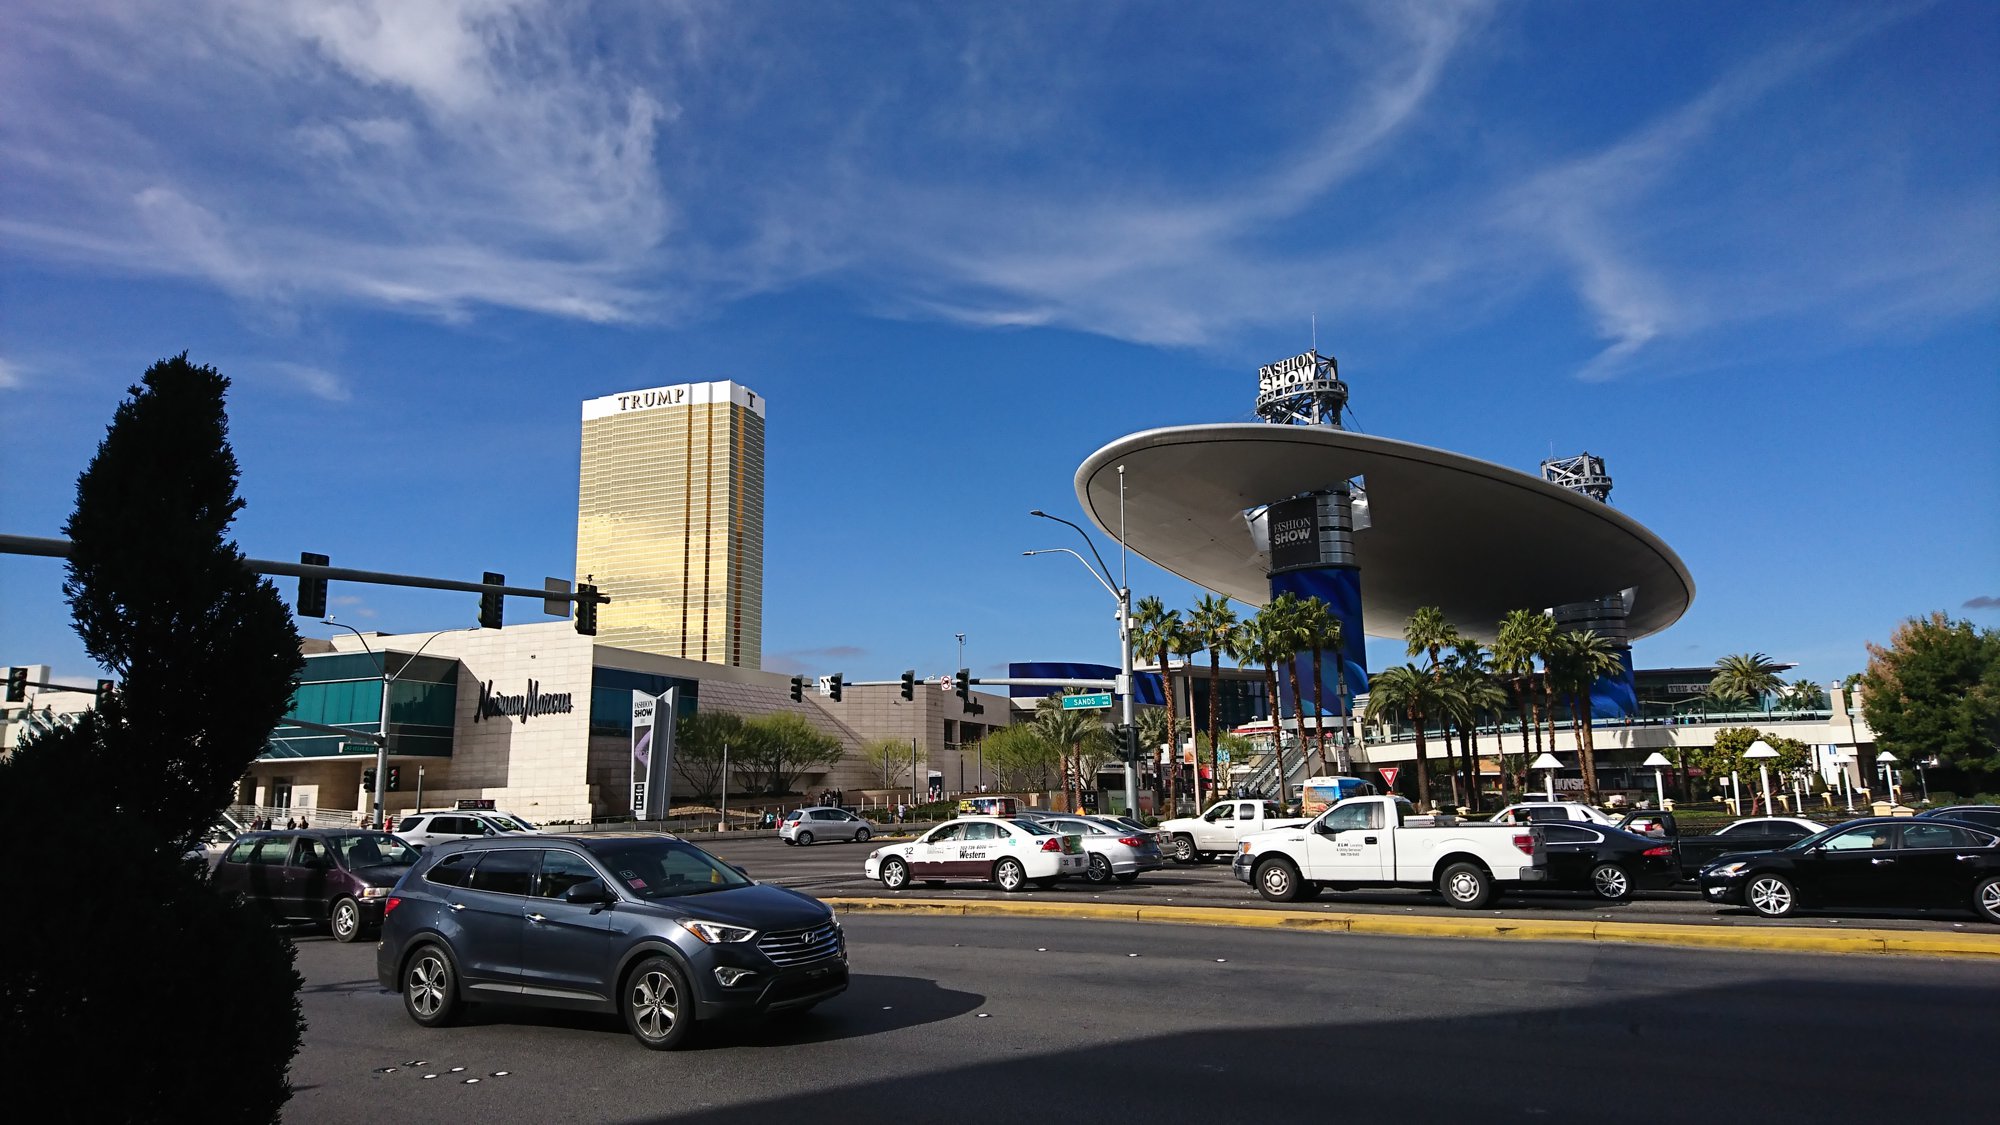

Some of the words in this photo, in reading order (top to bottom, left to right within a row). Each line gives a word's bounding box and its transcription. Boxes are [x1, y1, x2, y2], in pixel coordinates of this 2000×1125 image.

[1258, 350, 1316, 381] FASHION
[1259, 364, 1317, 395] SHOW
[618, 388, 685, 411] TRUMP
[747, 391, 756, 408] T
[1274, 517, 1311, 533] FASHION
[1274, 528, 1311, 545] SHOW
[474, 679, 525, 724] Neiman
[520, 678, 574, 724] Marcus
[634, 700, 653, 708] FASHION
[1073, 698, 1096, 706] SANDS
[634, 708, 653, 718] SHOW
[904, 846, 914, 855] 32
[959, 850, 986, 859] Western
